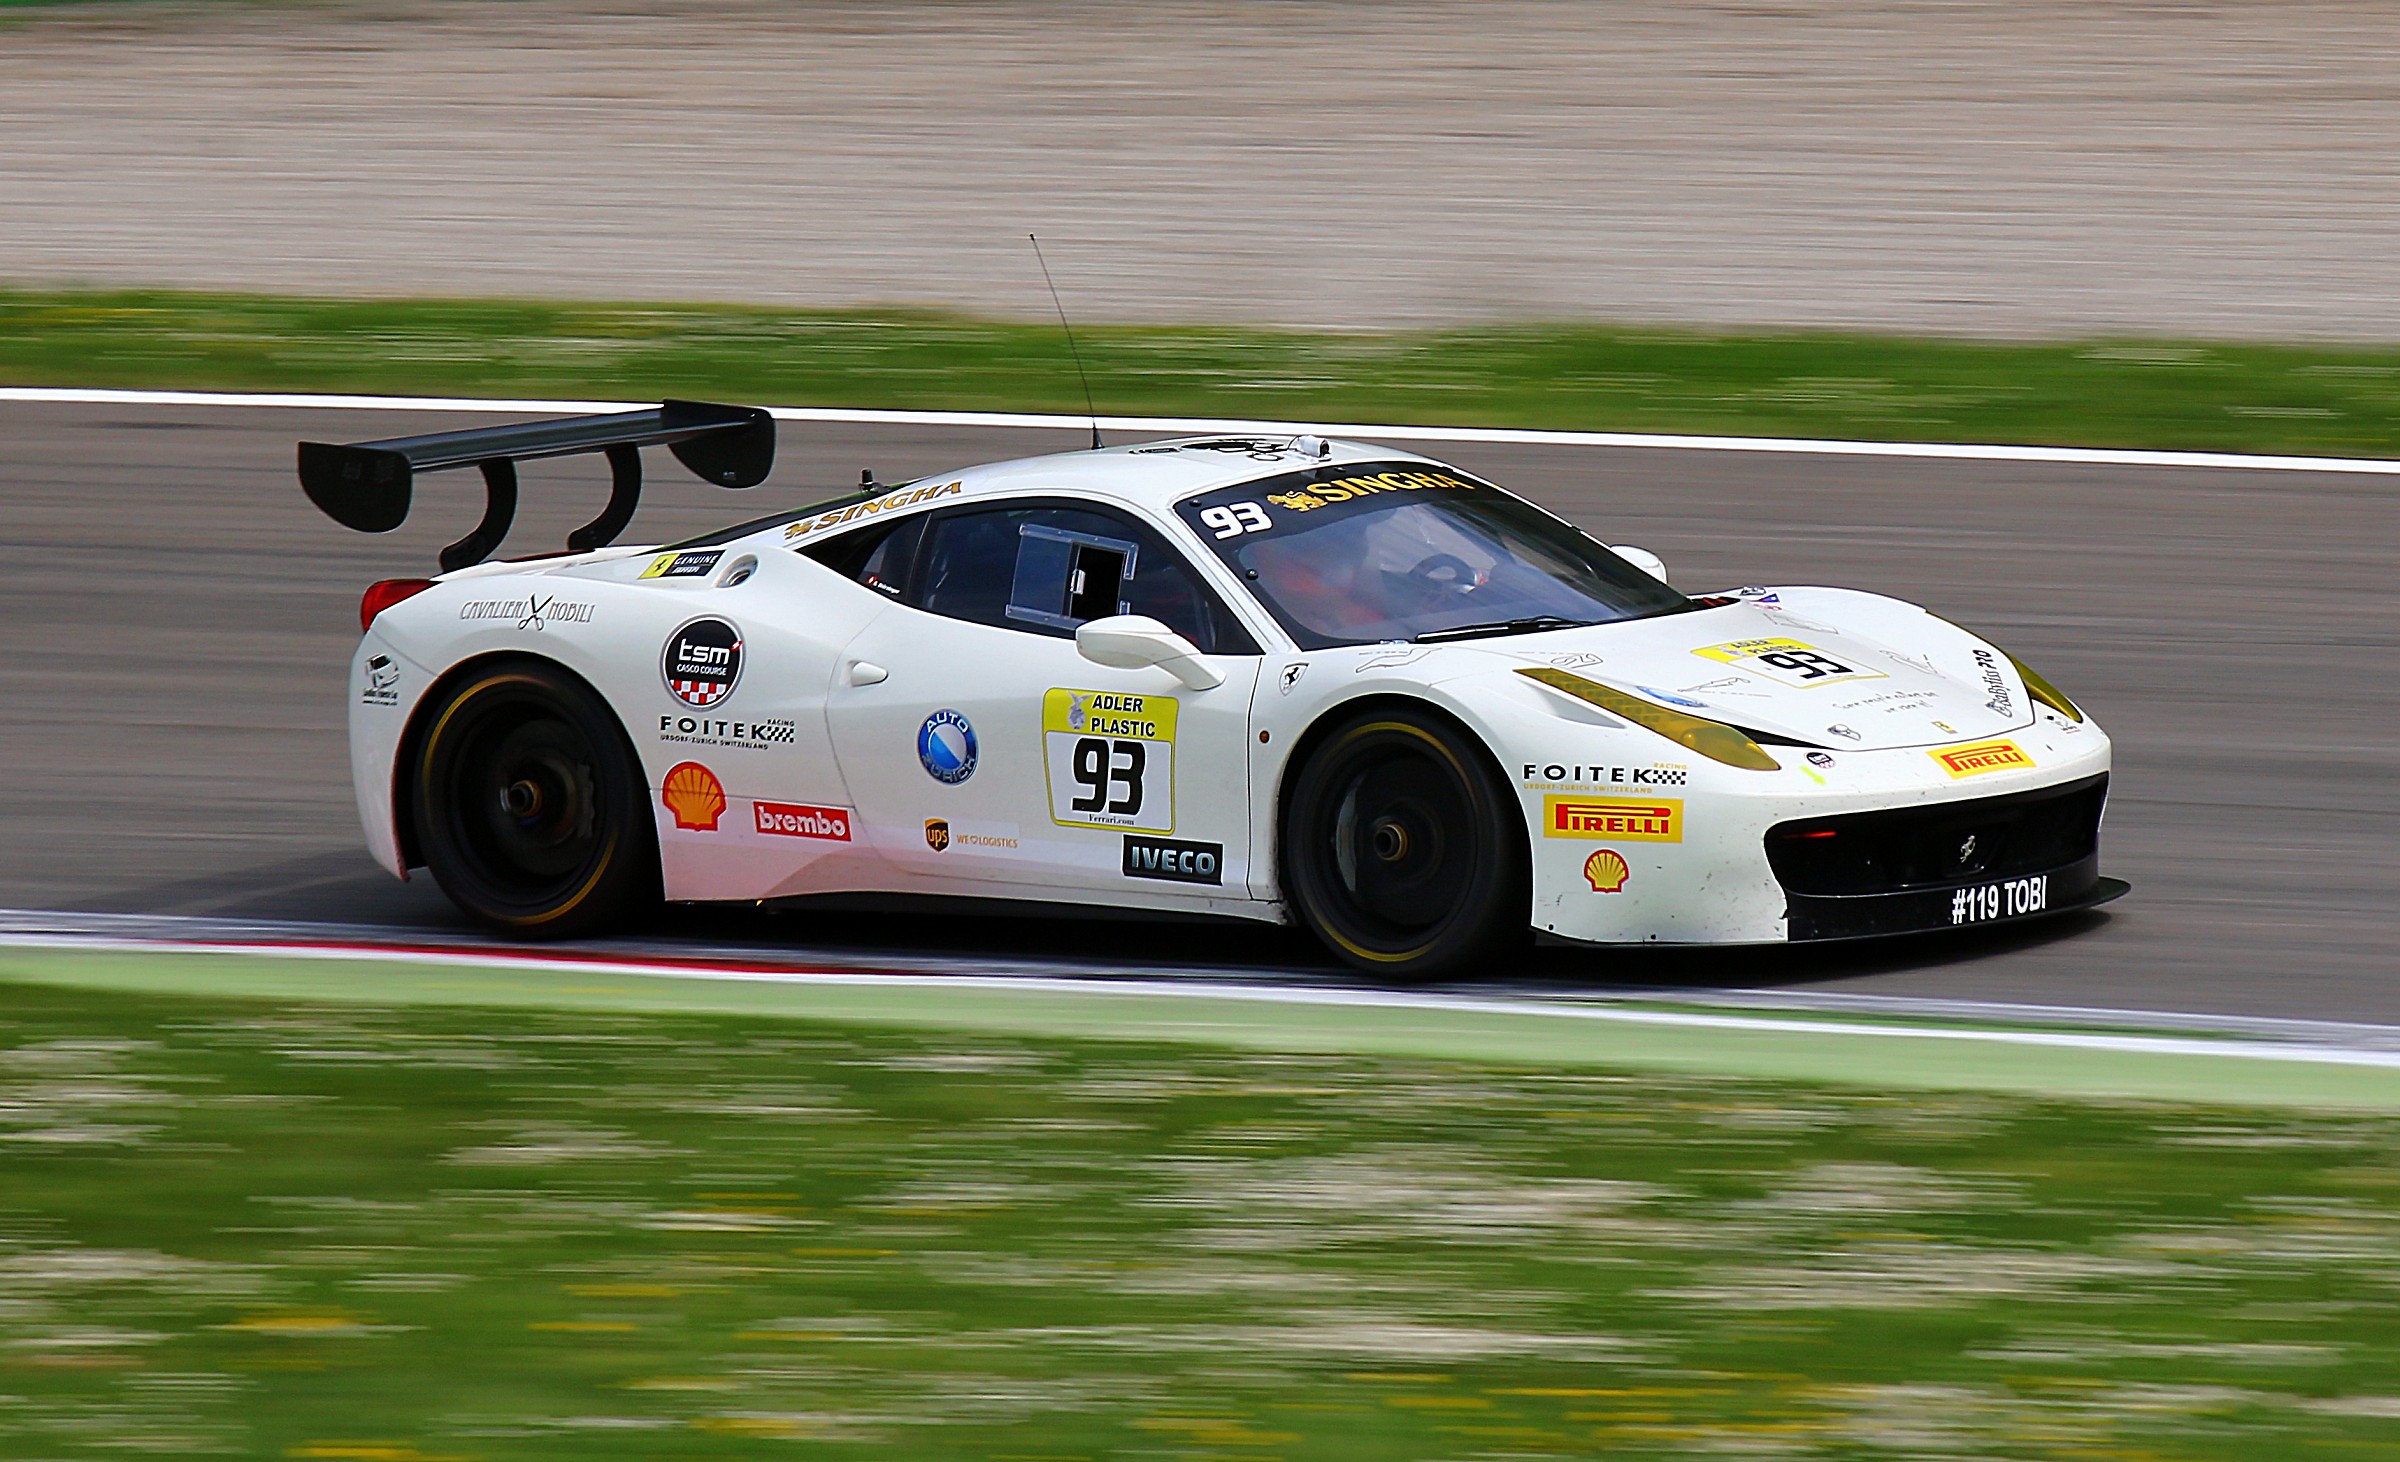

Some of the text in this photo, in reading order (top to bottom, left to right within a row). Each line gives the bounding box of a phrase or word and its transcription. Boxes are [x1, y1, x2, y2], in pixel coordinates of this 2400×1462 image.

[1307, 473, 1474, 502] SINGHA
[813, 481, 962, 530] SINGHA
[1201, 501, 1273, 540] 93
[674, 554, 719, 566] GENUINE
[459, 601, 596, 623] CAVALIERI NOBILI
[679, 639, 730, 664] tsm
[676, 663, 727, 676] CASCO COURSE
[1758, 650, 1854, 680] 93
[1092, 694, 1143, 713] ADLER
[660, 716, 767, 741] FOITEK
[767, 719, 795, 727] RACING
[926, 711, 969, 733] AUTO
[1091, 717, 1156, 737] PLASTIC
[1653, 762, 1688, 770] RACING
[1940, 745, 2025, 773] PIRELLI
[1072, 737, 1146, 816] 93
[1523, 764, 1653, 784] FOITEK
[1593, 785, 1654, 794] SWITZERLAND
[758, 805, 847, 837] brembo
[1088, 813, 1135, 826] Ferrari.com
[1555, 803, 1671, 834] PIRELLI
[926, 827, 948, 848] ups
[956, 833, 1019, 848] WE LOGISTICS
[1131, 846, 1215, 875] IVECO
[1951, 875, 2048, 925] #119 TOBI
